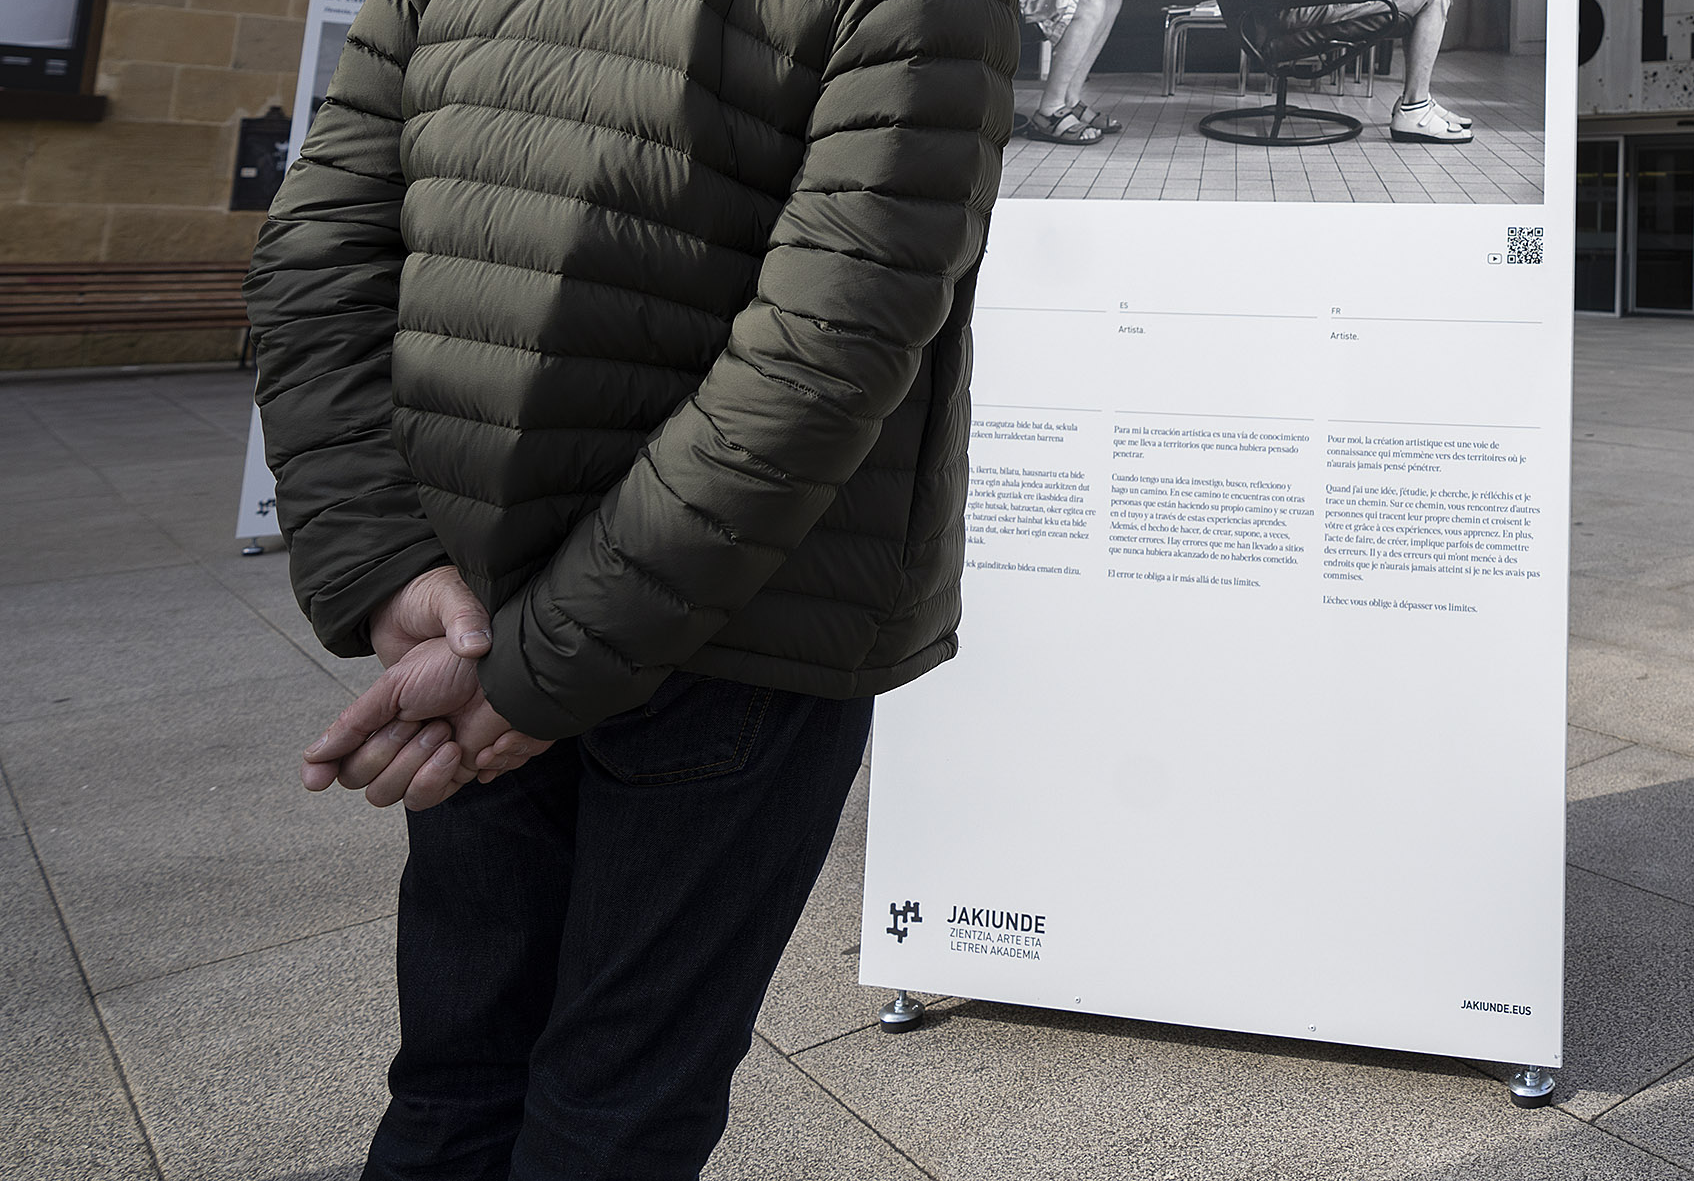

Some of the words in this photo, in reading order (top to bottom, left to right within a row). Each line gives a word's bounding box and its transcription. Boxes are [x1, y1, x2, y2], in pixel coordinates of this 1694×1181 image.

[1118, 325, 1146, 334] Artista.
[1330, 331, 1360, 341] Artiste.
[947, 906, 1046, 934] JAKIUNDE
[950, 928, 994, 943] ZIENTZIA,
[997, 934, 1021, 945] ARTE
[1025, 936, 1042, 947] ETA
[951, 941, 987, 954] LETREN
[990, 946, 1040, 960] AKADEMIA
[1461, 1000, 1531, 1016] JAKIUNDE.EUS
